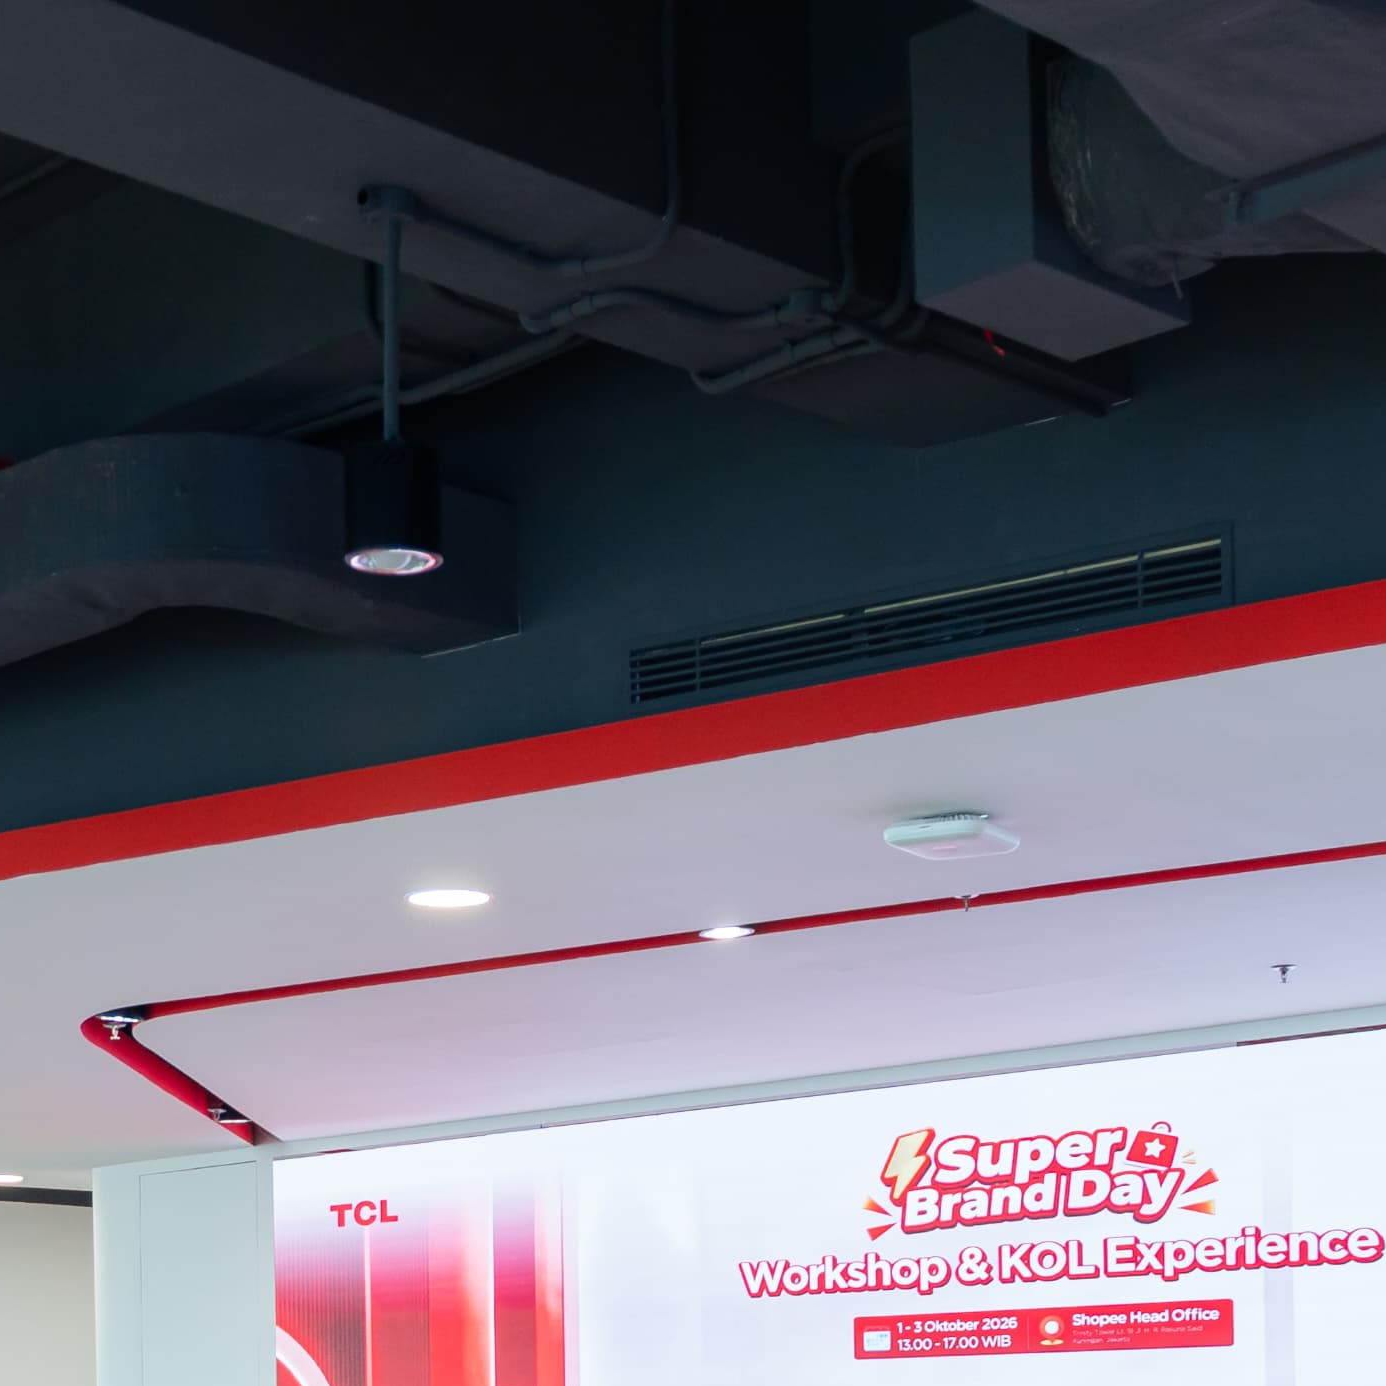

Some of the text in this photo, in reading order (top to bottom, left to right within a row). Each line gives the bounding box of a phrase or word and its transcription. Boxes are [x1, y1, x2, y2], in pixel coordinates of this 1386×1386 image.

[932, 1127, 1126, 1187] Super
[903, 1168, 1183, 1229] Brand Day
[330, 1199, 398, 1227] TCL
[739, 1226, 1383, 1296] Workshop & KOL Experience
[896, 1322, 903, 1334] 1
[913, 1321, 923, 1333] 3
[924, 1319, 979, 1333] Oktober
[981, 1316, 1018, 1331] 2026
[1071, 1307, 1221, 1327] Shopee Head Office
[896, 1338, 933, 1351] 13.00
[942, 1336, 979, 1350] 17.00
[981, 1334, 1012, 1348] WIB
